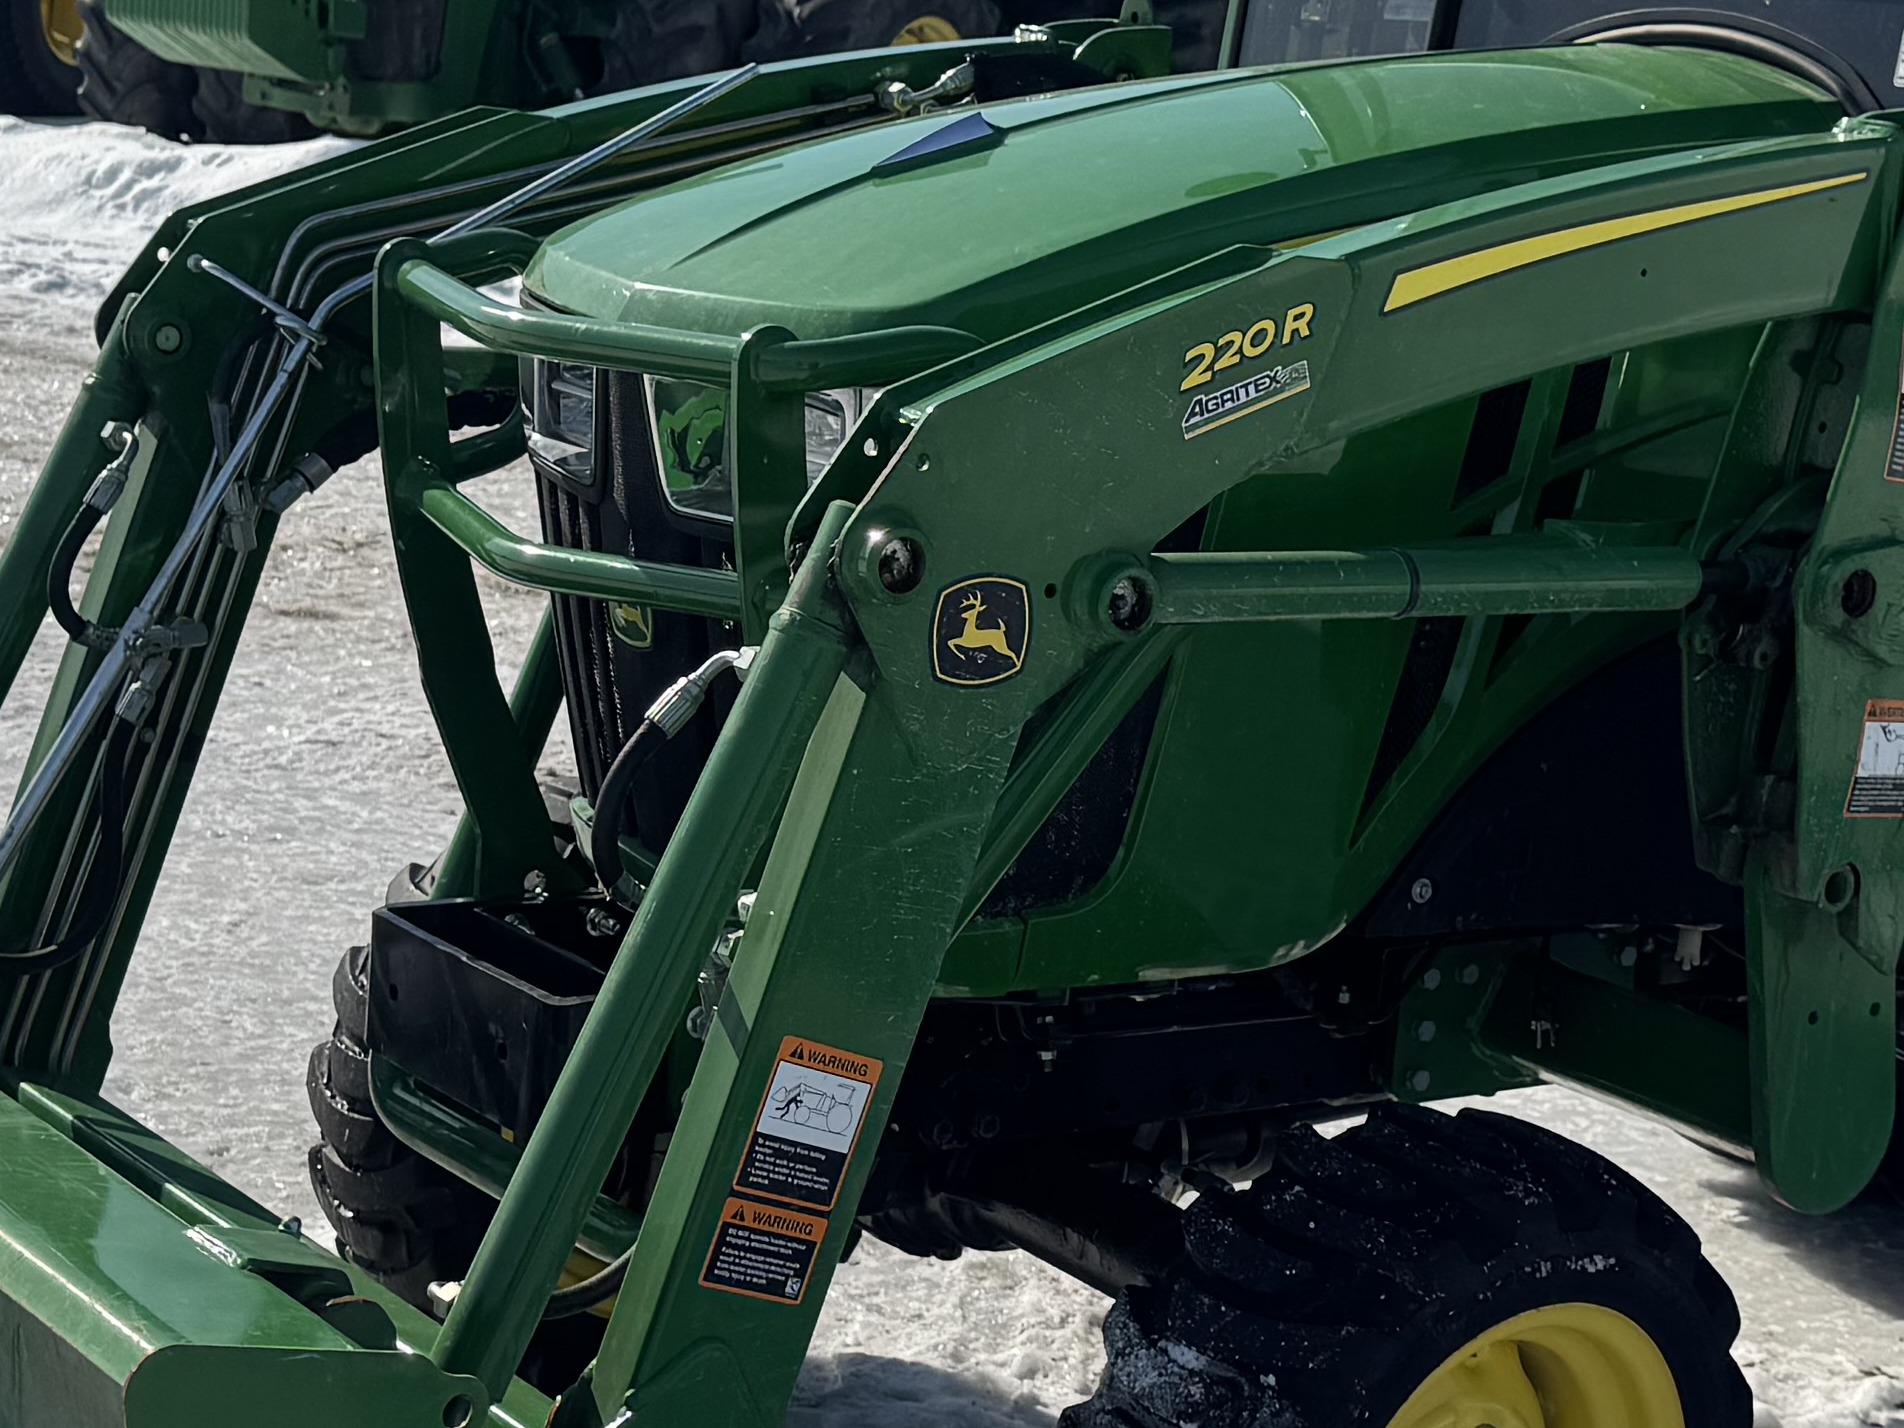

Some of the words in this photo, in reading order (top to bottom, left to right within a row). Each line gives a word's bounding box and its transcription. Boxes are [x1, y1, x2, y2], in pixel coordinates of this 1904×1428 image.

[1184, 368, 1282, 424] AGRITEX
[807, 1049, 869, 1077] WARNING
[752, 1211, 814, 1236] WARNING
